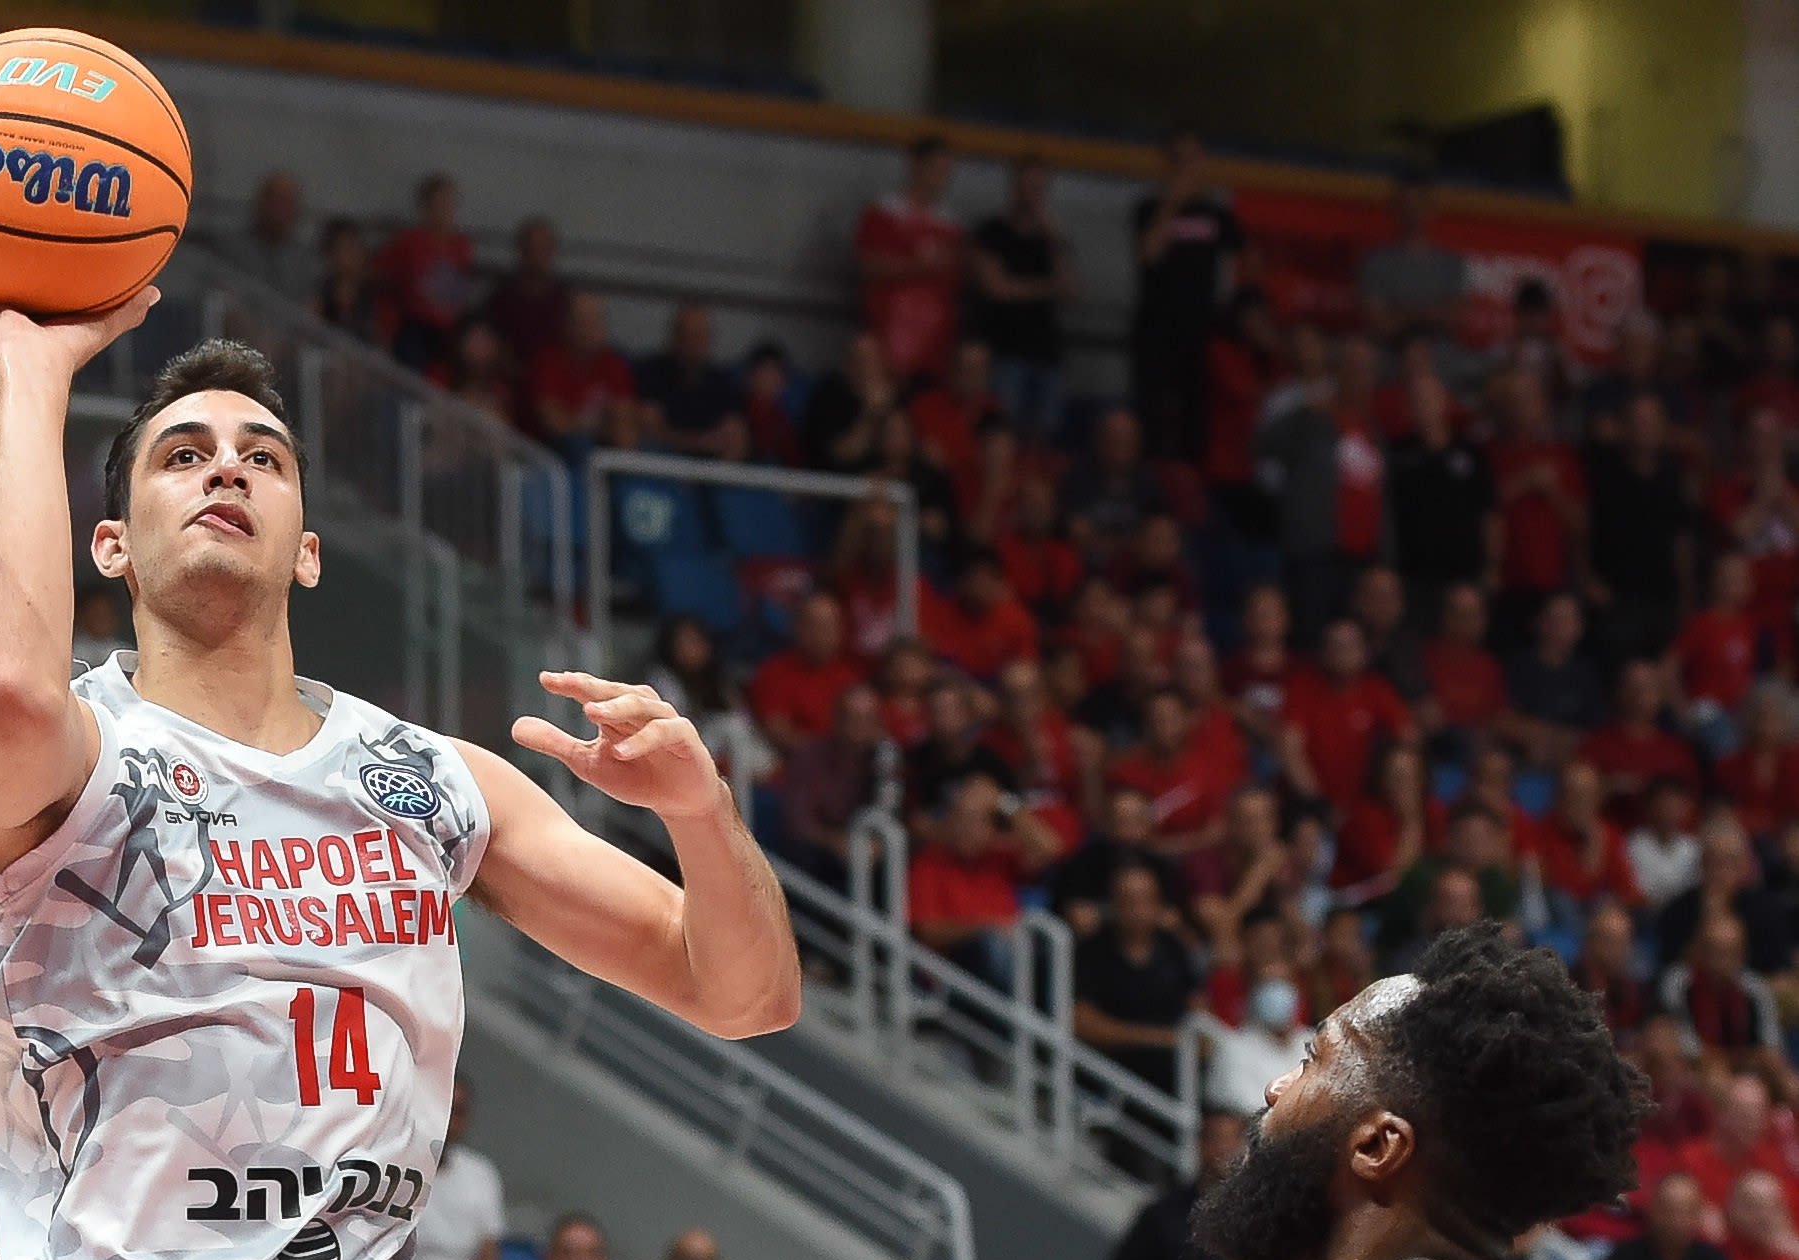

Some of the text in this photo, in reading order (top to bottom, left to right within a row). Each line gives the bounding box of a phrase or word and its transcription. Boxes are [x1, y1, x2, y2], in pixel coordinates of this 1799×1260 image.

[208, 828, 417, 890] HAPOEL
[191, 889, 455, 947] JERUSALEM
[289, 986, 382, 1107] 14
[186, 1159, 424, 1222] בנק יהב
